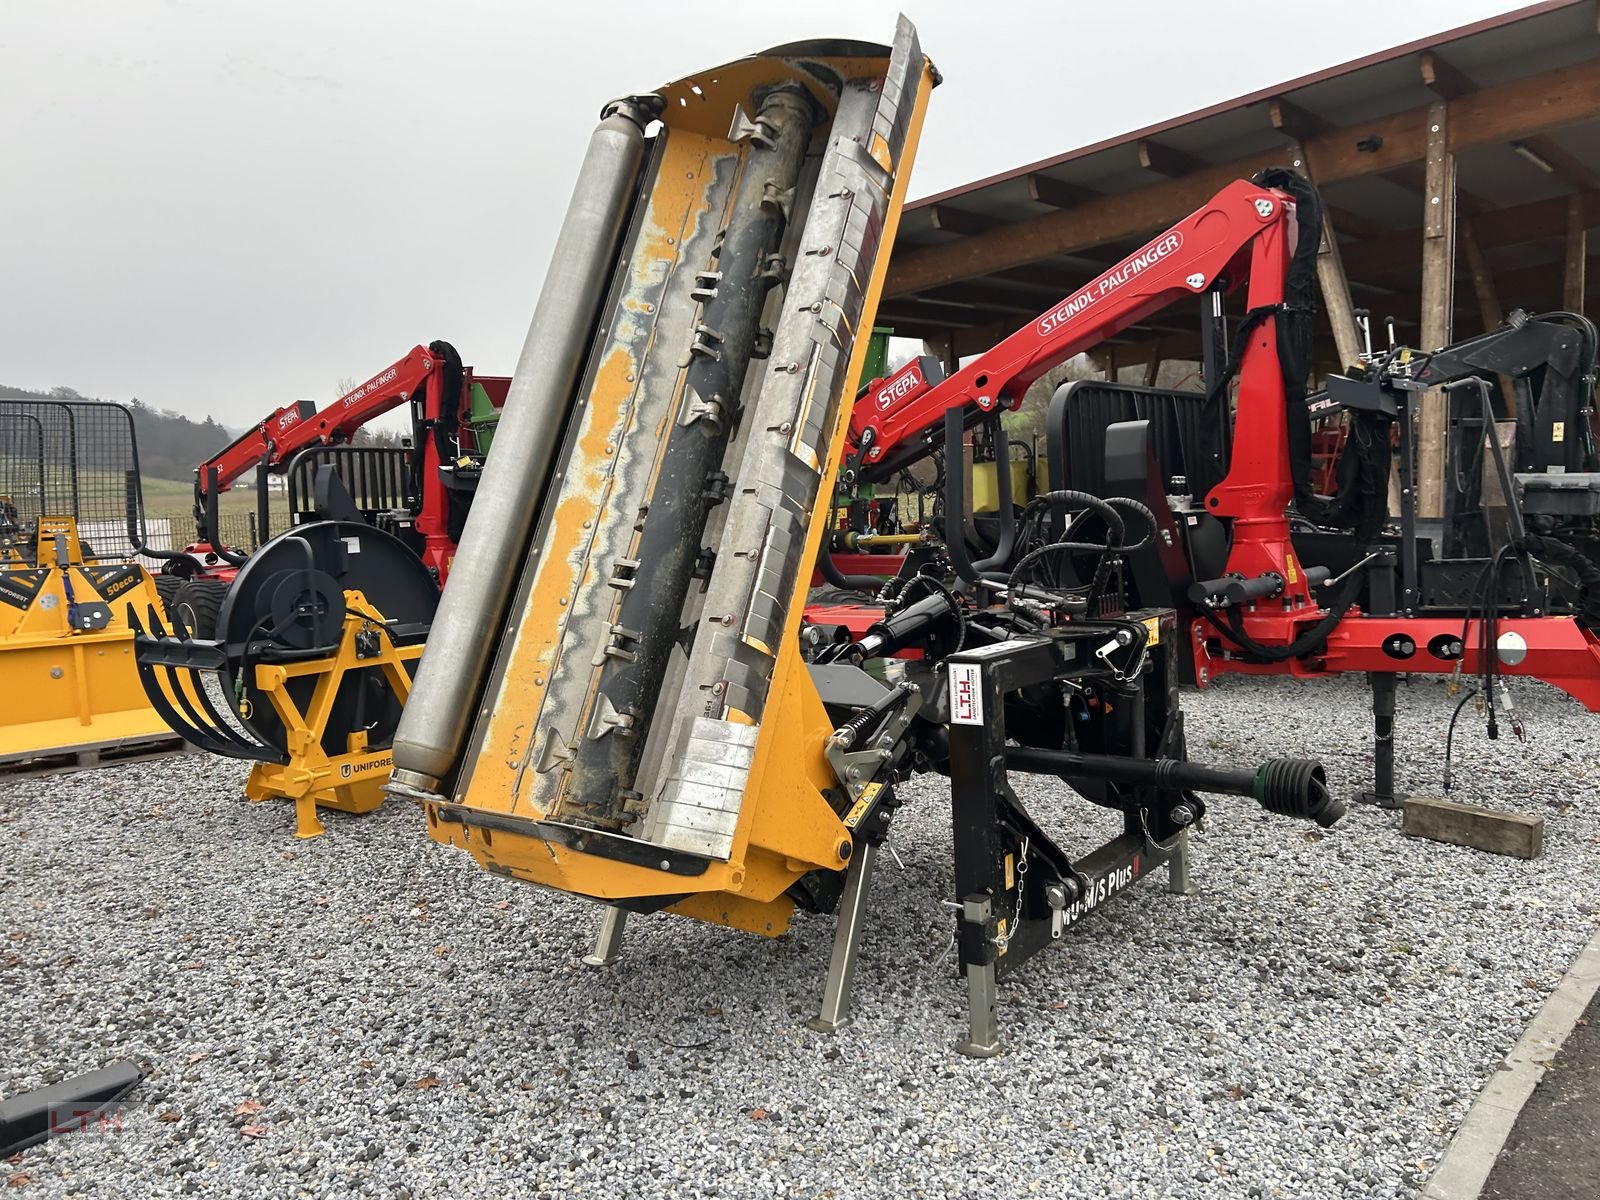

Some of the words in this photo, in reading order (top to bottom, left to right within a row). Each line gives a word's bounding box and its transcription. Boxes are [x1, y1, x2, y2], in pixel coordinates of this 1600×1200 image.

[1040, 234, 1179, 333] STEINDL-PALFINGER
[344, 368, 397, 407] STEINDL-PALFINGER
[878, 373, 919, 409] STEPA
[279, 410, 298, 430] STEPA
[106, 575, 134, 596] 50eco
[1107, 864, 1132, 896] Plus
